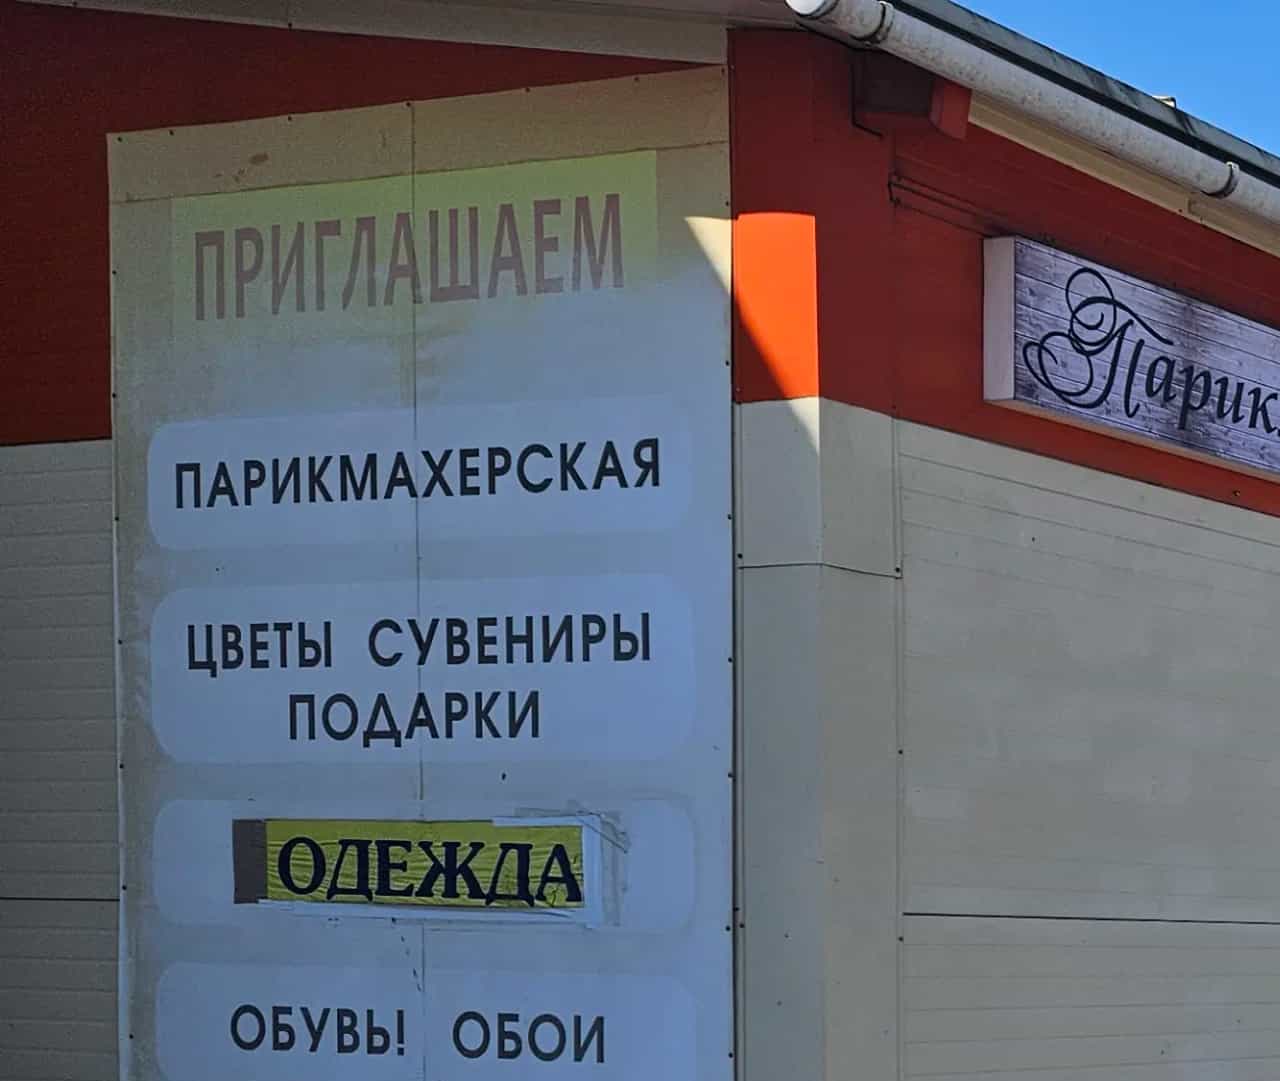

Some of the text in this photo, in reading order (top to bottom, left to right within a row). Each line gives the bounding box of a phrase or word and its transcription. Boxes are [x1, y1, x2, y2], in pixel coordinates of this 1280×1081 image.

[194, 193, 625, 321] ПРИГЛАШАЕМ
[175, 437, 661, 510] ПАРИКМАХЕРСКАЯ
[186, 612, 651, 678] ЦВЕТЫ СУВЕНИРЫ
[288, 690, 541, 748] ПОДАРКИ
[277, 836, 582, 907] ОДЕЖДА
[230, 1004, 606, 1063] ОБУВЬ! ОБОИ
